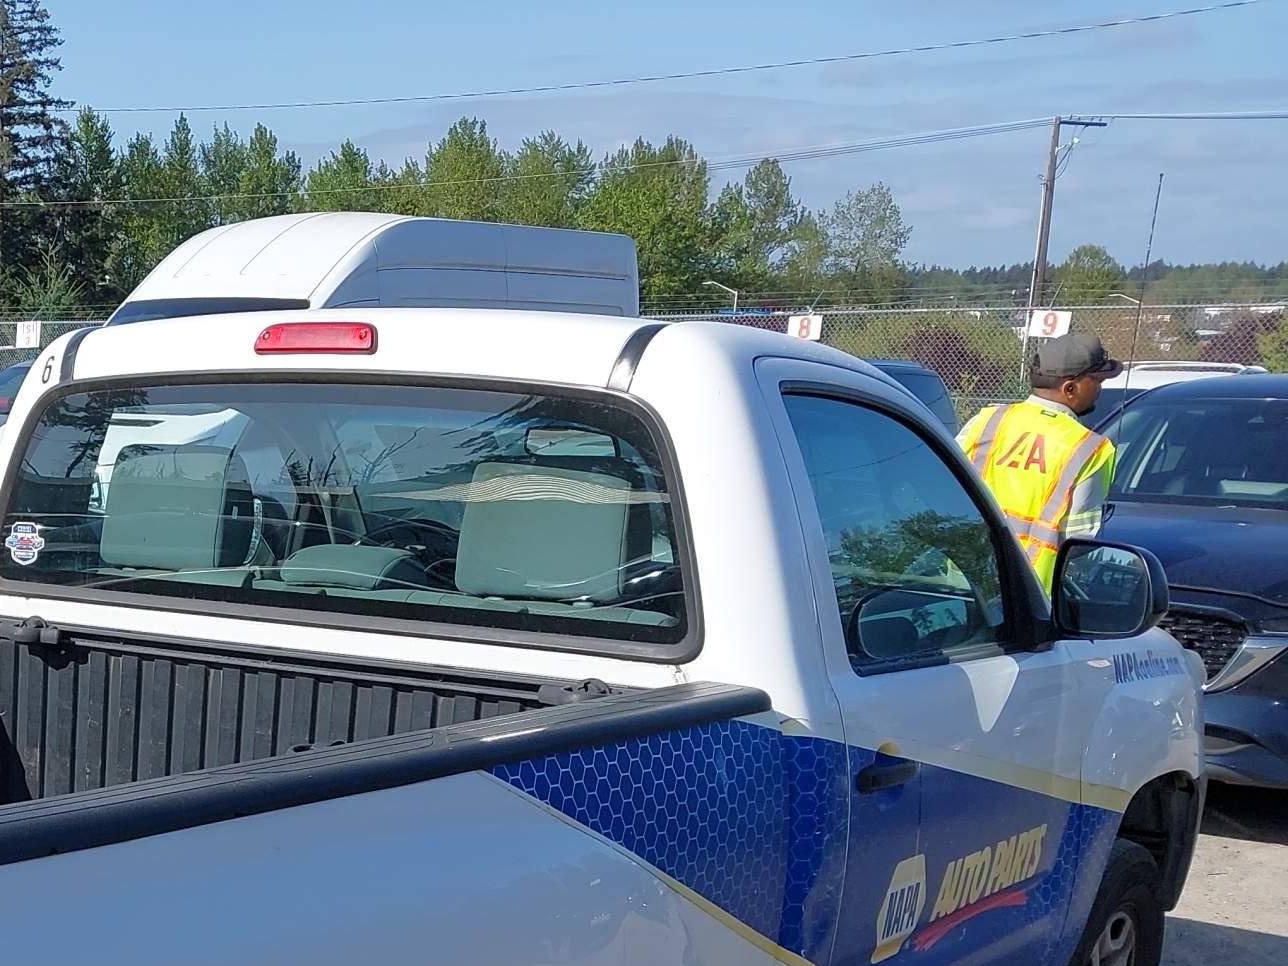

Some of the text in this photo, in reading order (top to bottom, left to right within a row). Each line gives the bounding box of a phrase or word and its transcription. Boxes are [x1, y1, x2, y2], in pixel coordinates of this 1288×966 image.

[797, 316, 811, 340] 8
[1041, 311, 1058, 336] 9
[41, 355, 55, 384] 6
[928, 823, 1048, 922] AUTO PARTS
[881, 882, 921, 941] NAPA
